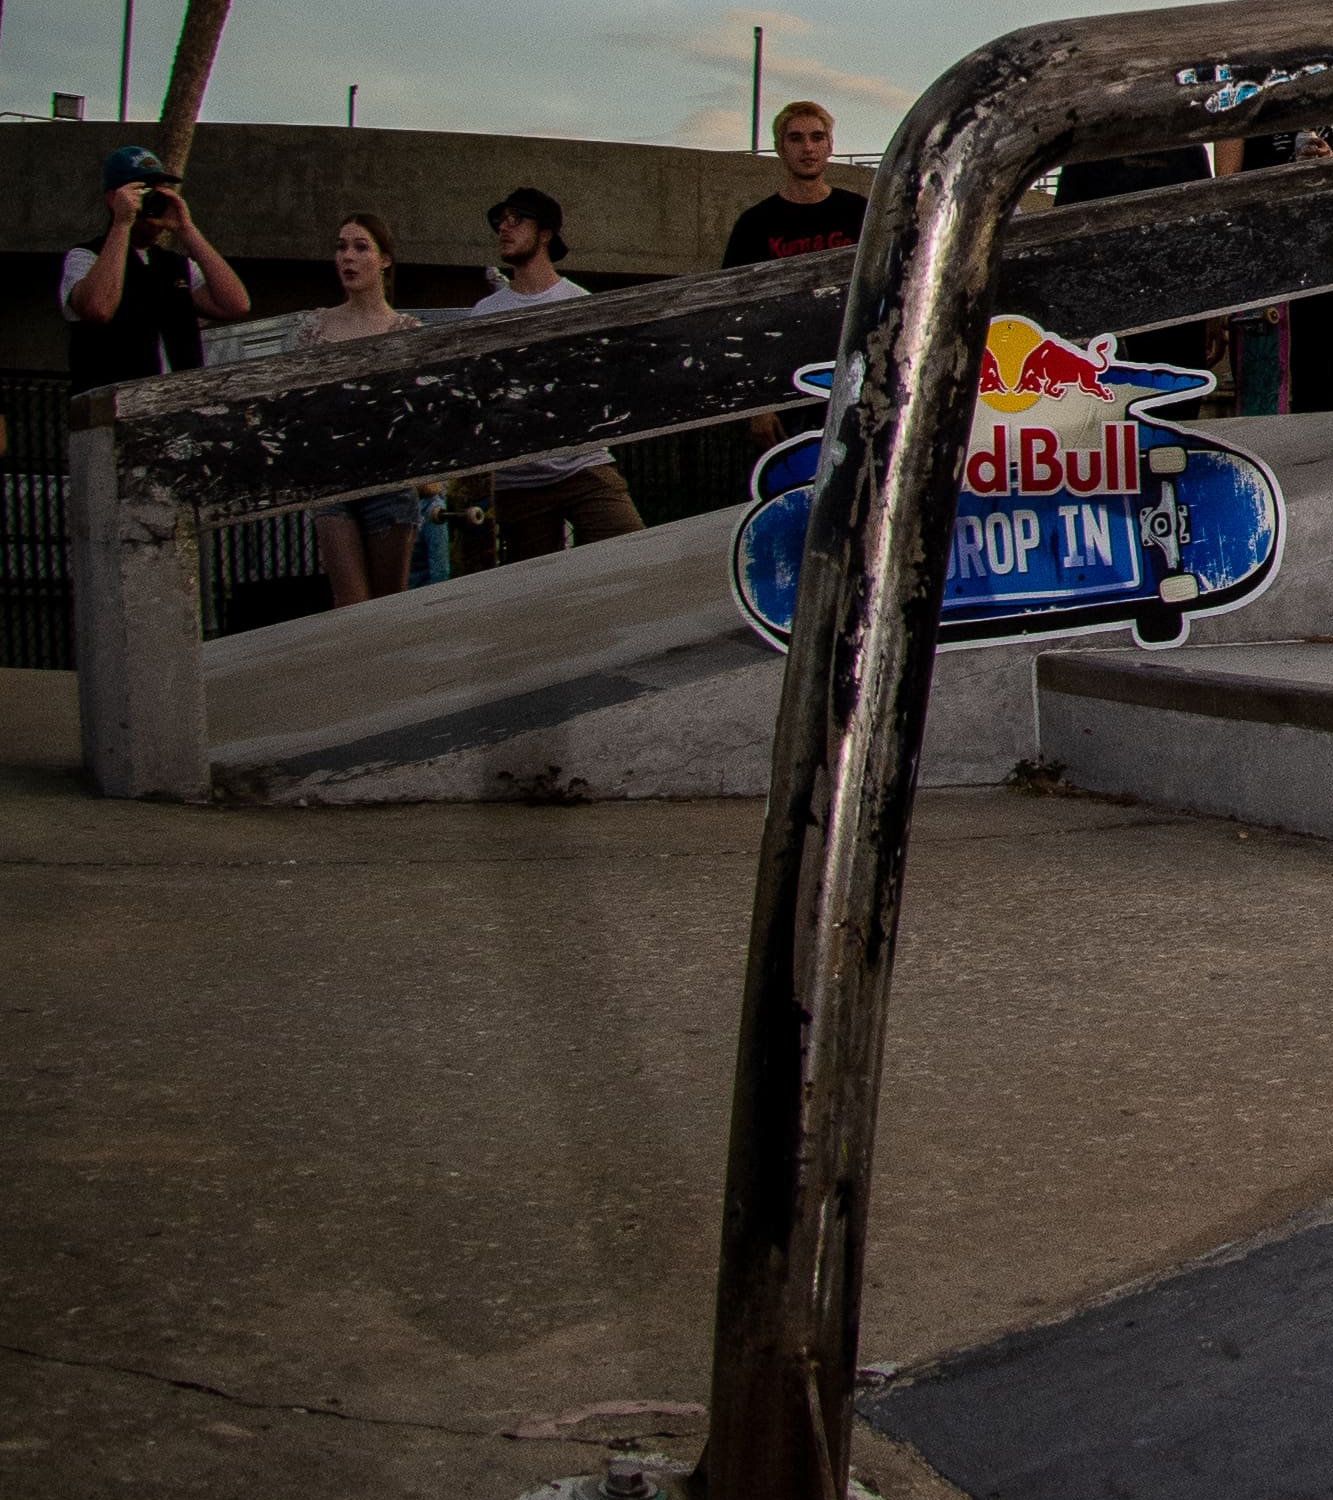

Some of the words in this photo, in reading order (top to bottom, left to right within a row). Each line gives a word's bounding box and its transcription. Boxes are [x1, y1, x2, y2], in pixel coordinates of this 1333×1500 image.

[1020, 424, 1138, 493] Bull
[945, 509, 1040, 579] ROP
[1059, 504, 1113, 568] IN
